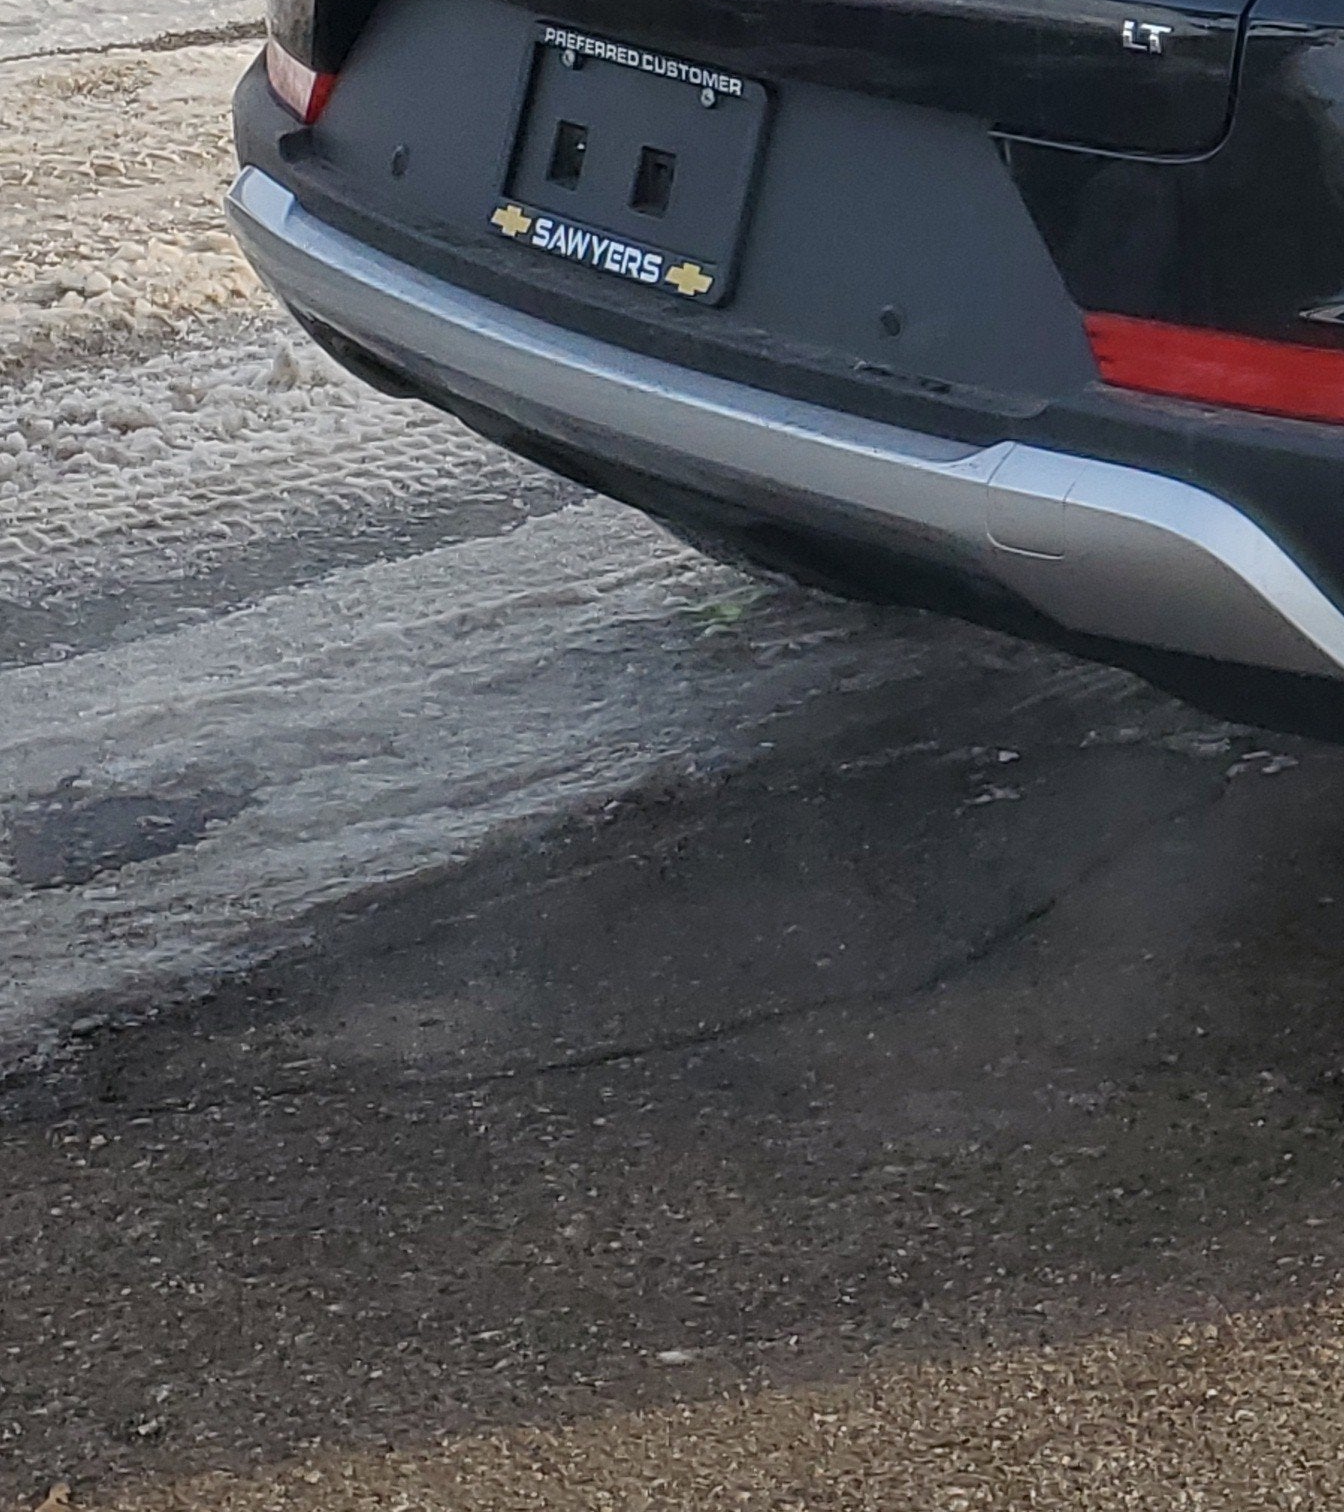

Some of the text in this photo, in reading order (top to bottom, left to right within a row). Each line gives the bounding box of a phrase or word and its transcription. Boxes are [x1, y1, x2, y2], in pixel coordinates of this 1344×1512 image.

[544, 27, 743, 96] PREFERRED CUSTOMER
[1122, 19, 1173, 55] LT
[531, 217, 663, 284] SAWYERS
